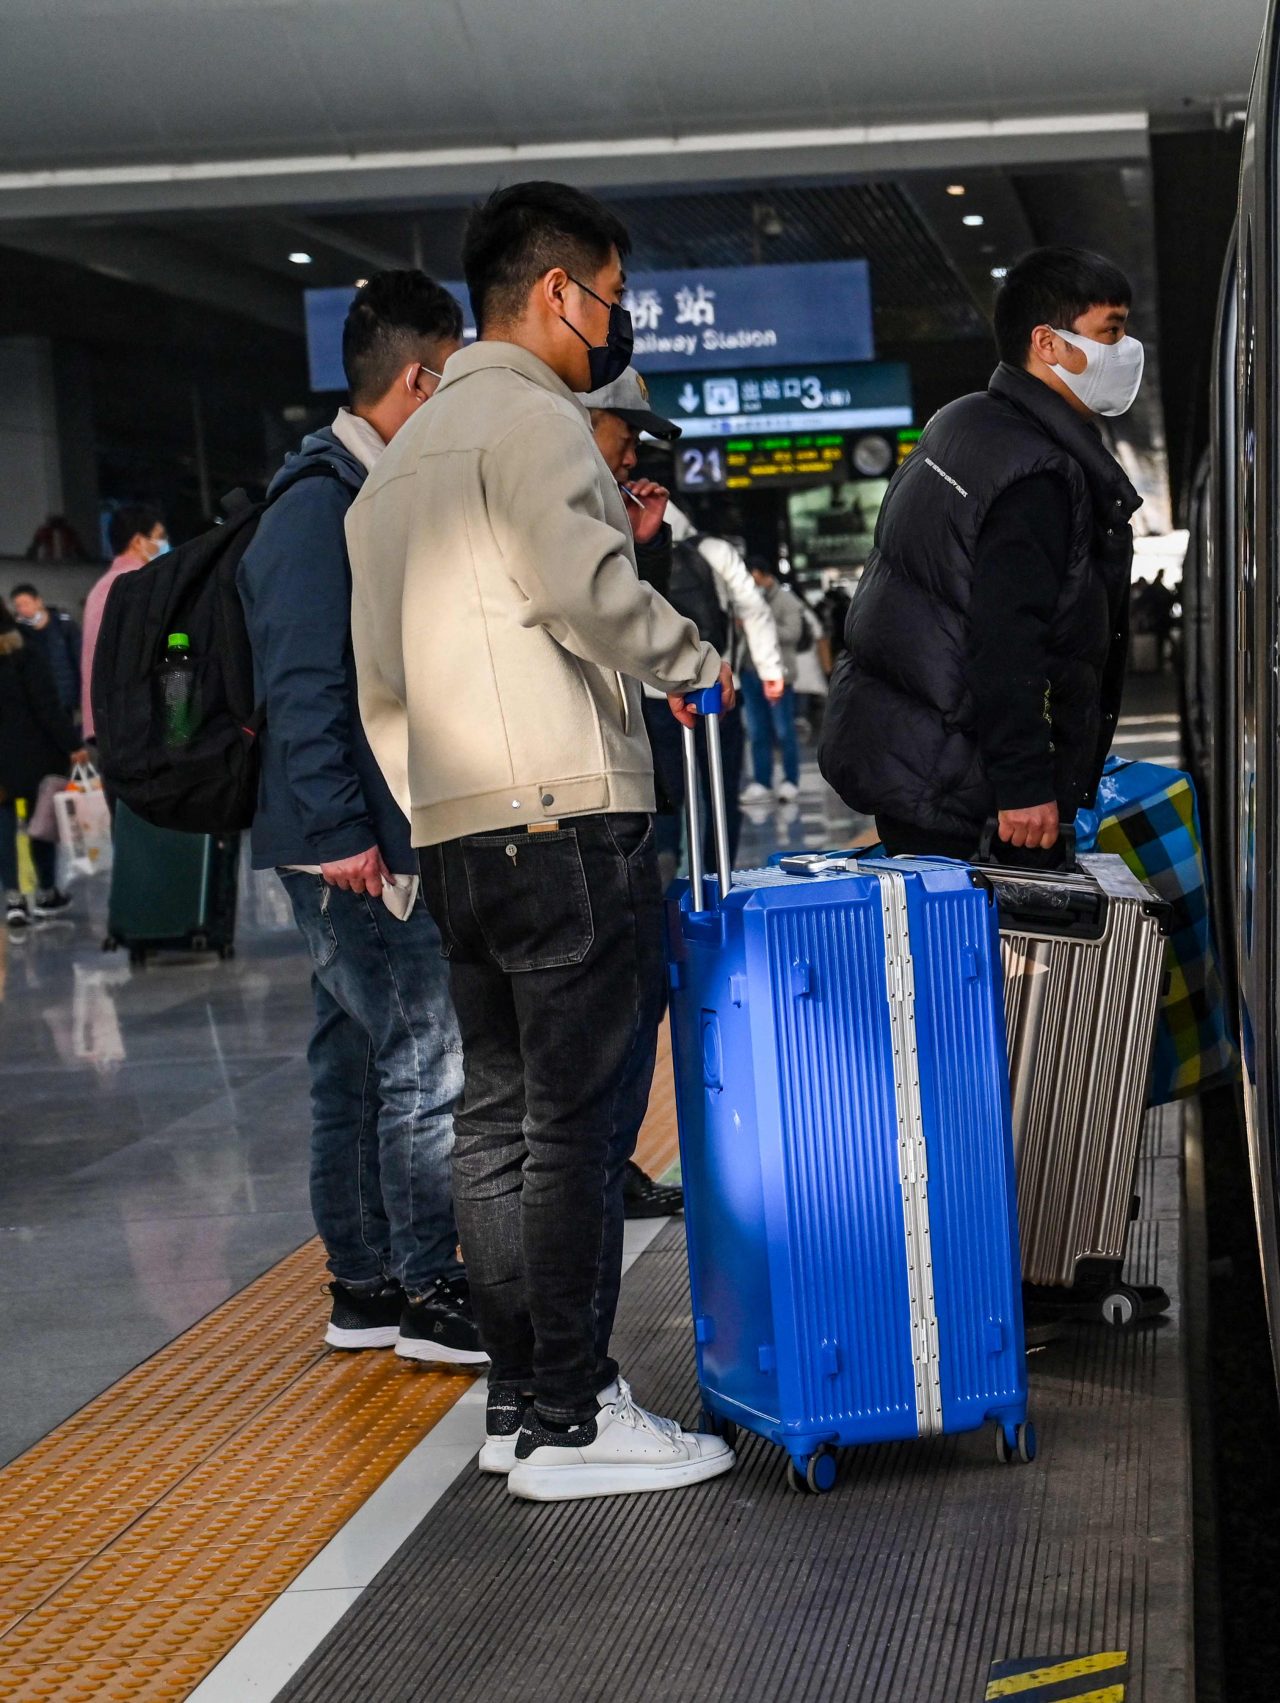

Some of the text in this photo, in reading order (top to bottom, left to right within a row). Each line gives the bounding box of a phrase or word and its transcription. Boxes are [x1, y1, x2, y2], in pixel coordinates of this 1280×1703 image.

[633, 328, 777, 356] ailway Station
[682, 449, 722, 485] 21
